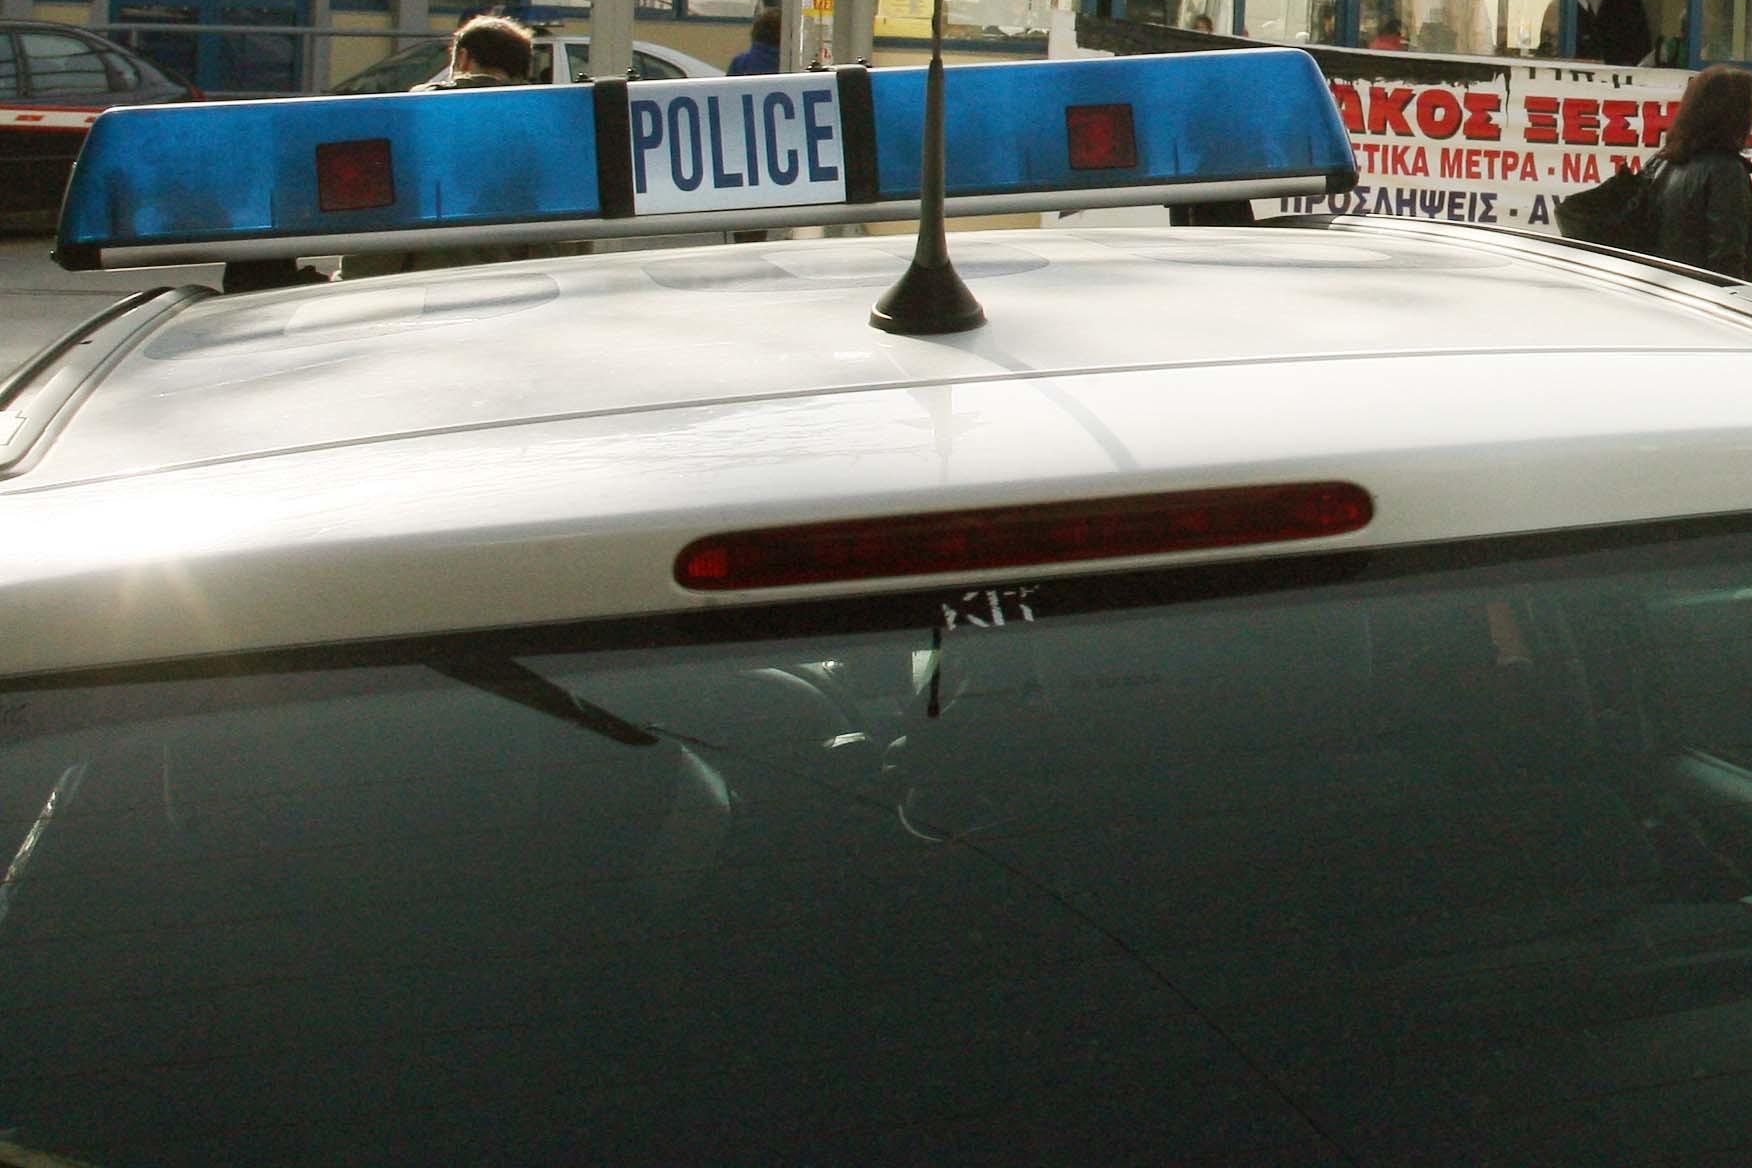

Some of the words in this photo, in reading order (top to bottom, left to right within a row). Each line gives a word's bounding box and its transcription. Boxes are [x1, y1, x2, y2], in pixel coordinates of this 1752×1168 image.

[631, 89, 840, 194] POLICE
[1330, 84, 1502, 142] ΑΚΟΣ
[1440, 149, 1539, 182] ΜΕΤΡΑ
[1562, 153, 1601, 183] ΝΑ
